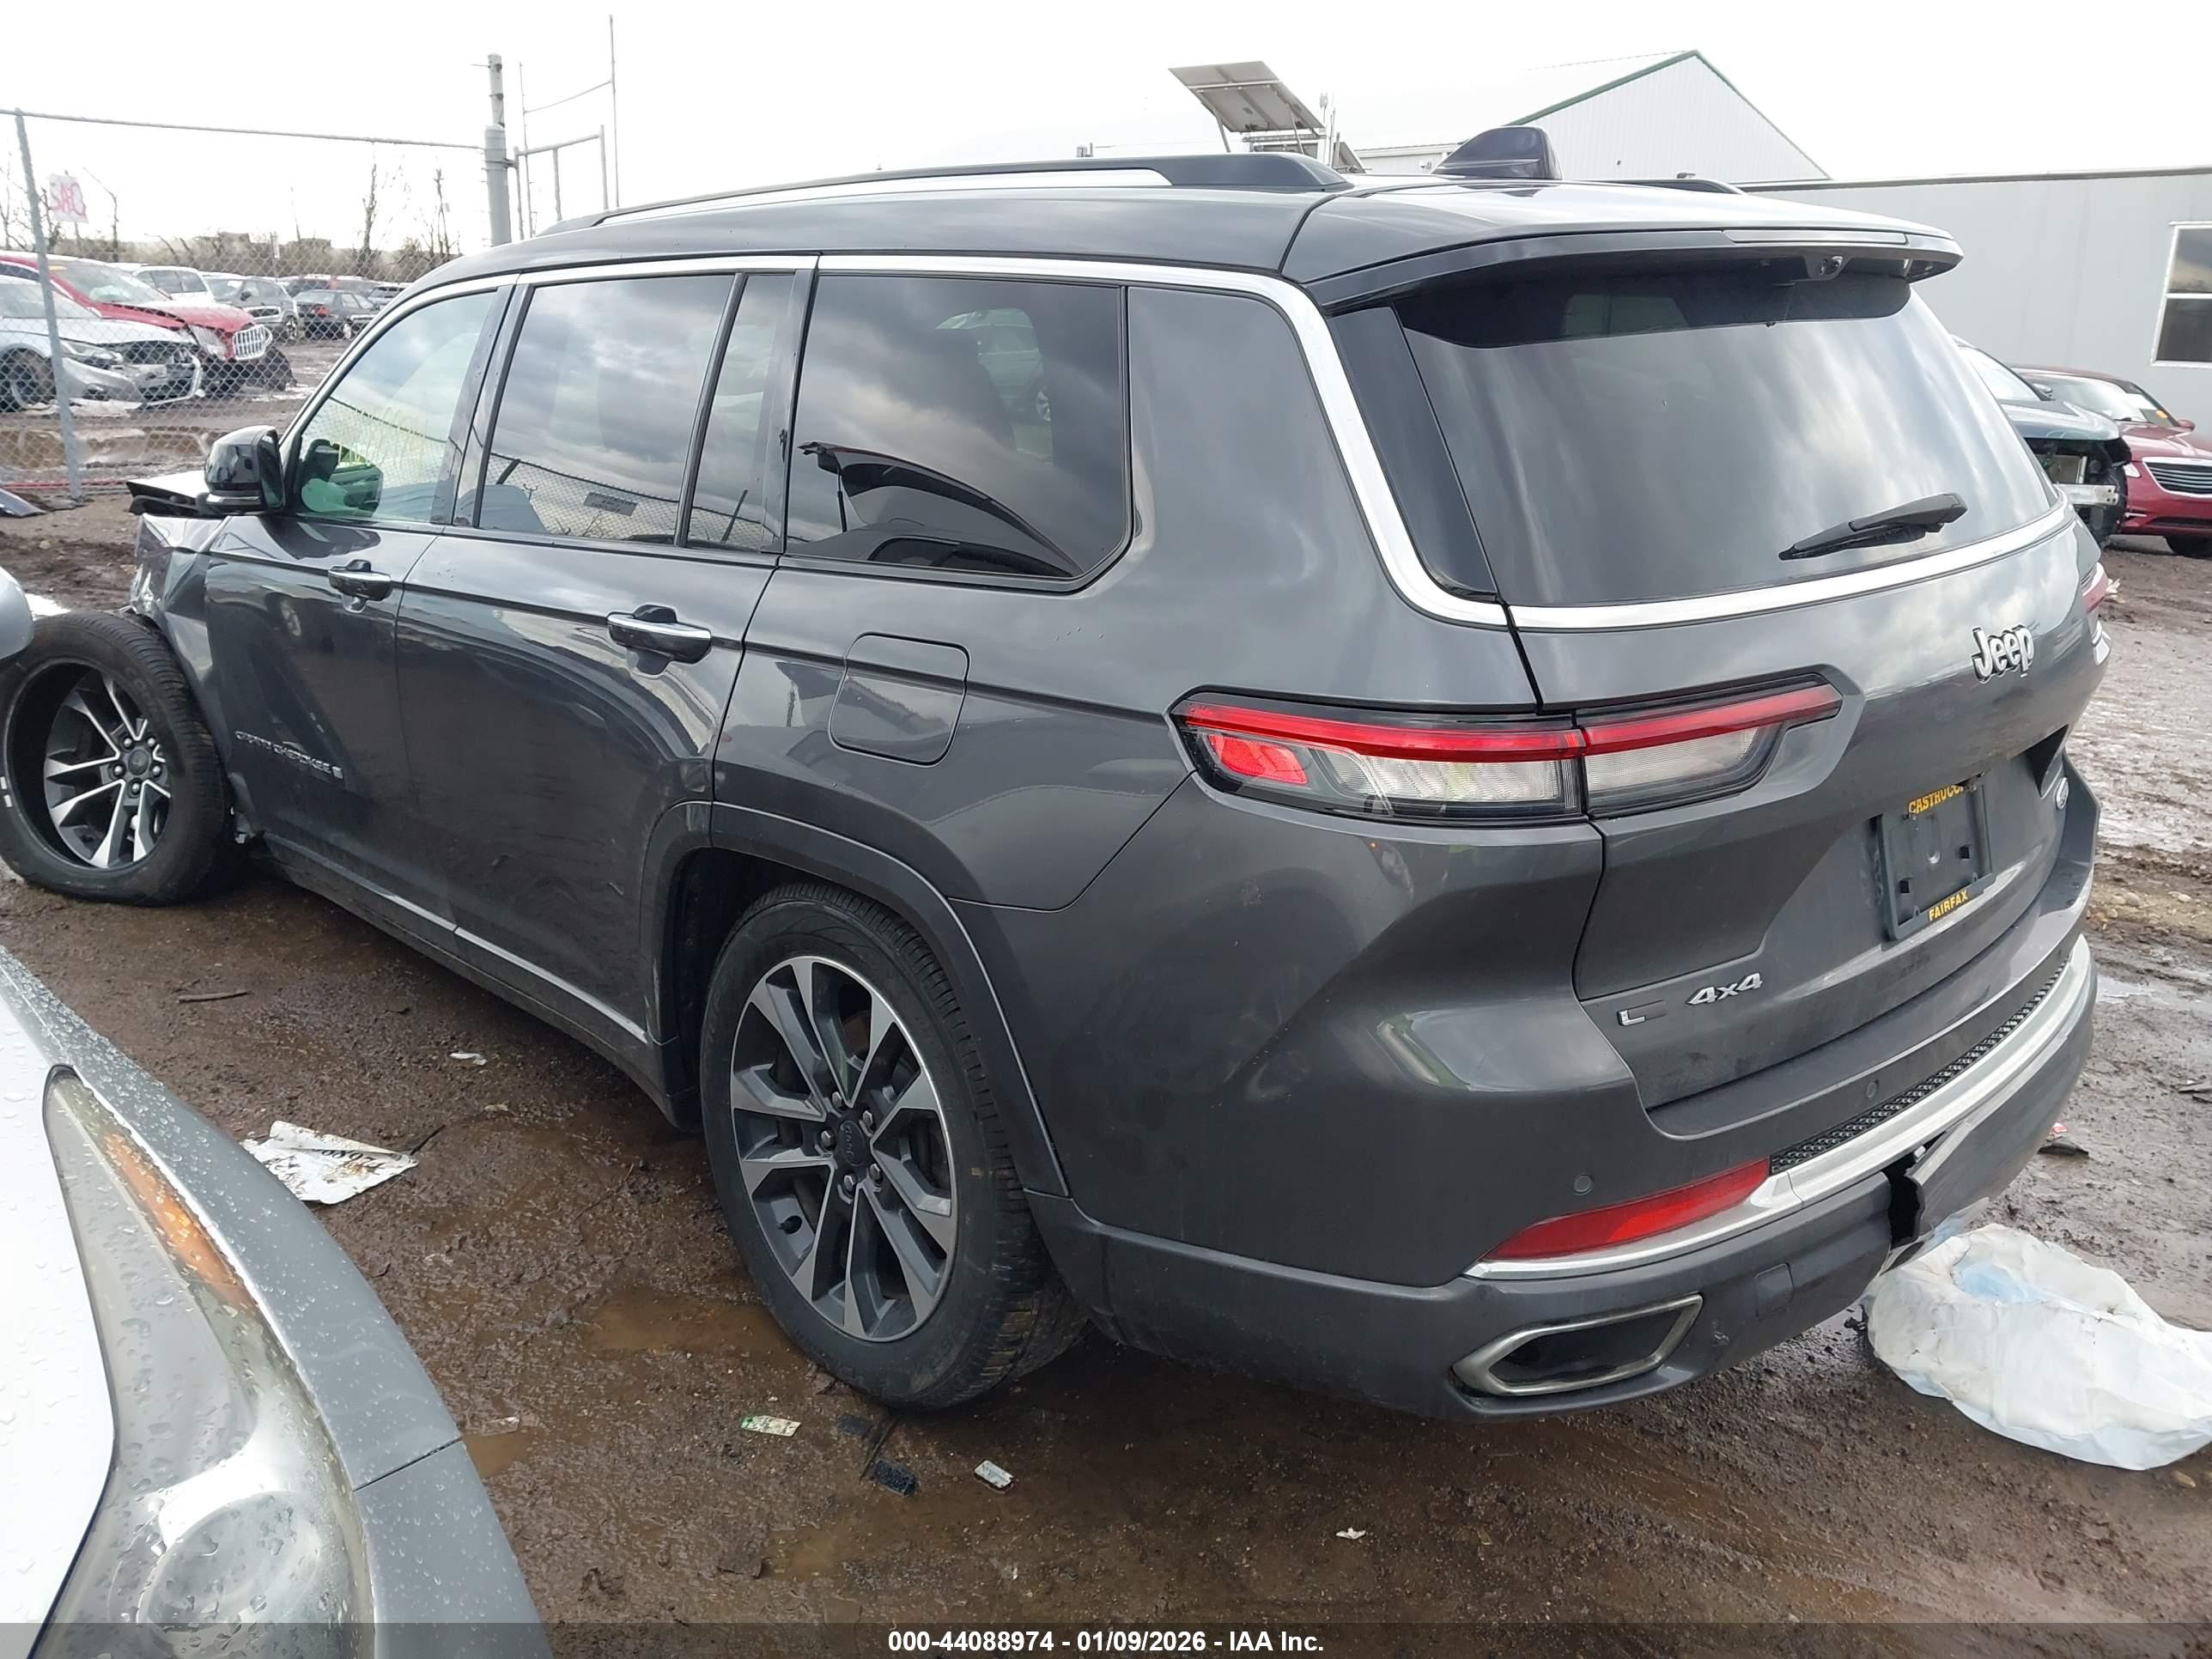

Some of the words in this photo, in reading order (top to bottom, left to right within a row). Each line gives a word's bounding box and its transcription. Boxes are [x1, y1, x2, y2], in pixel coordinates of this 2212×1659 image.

[1972, 624, 2034, 683] Jeep
[1929, 890, 1968, 921] FAIRFAX
[1686, 972, 1763, 1006] 4x4
[1618, 1009, 1645, 1026] L
